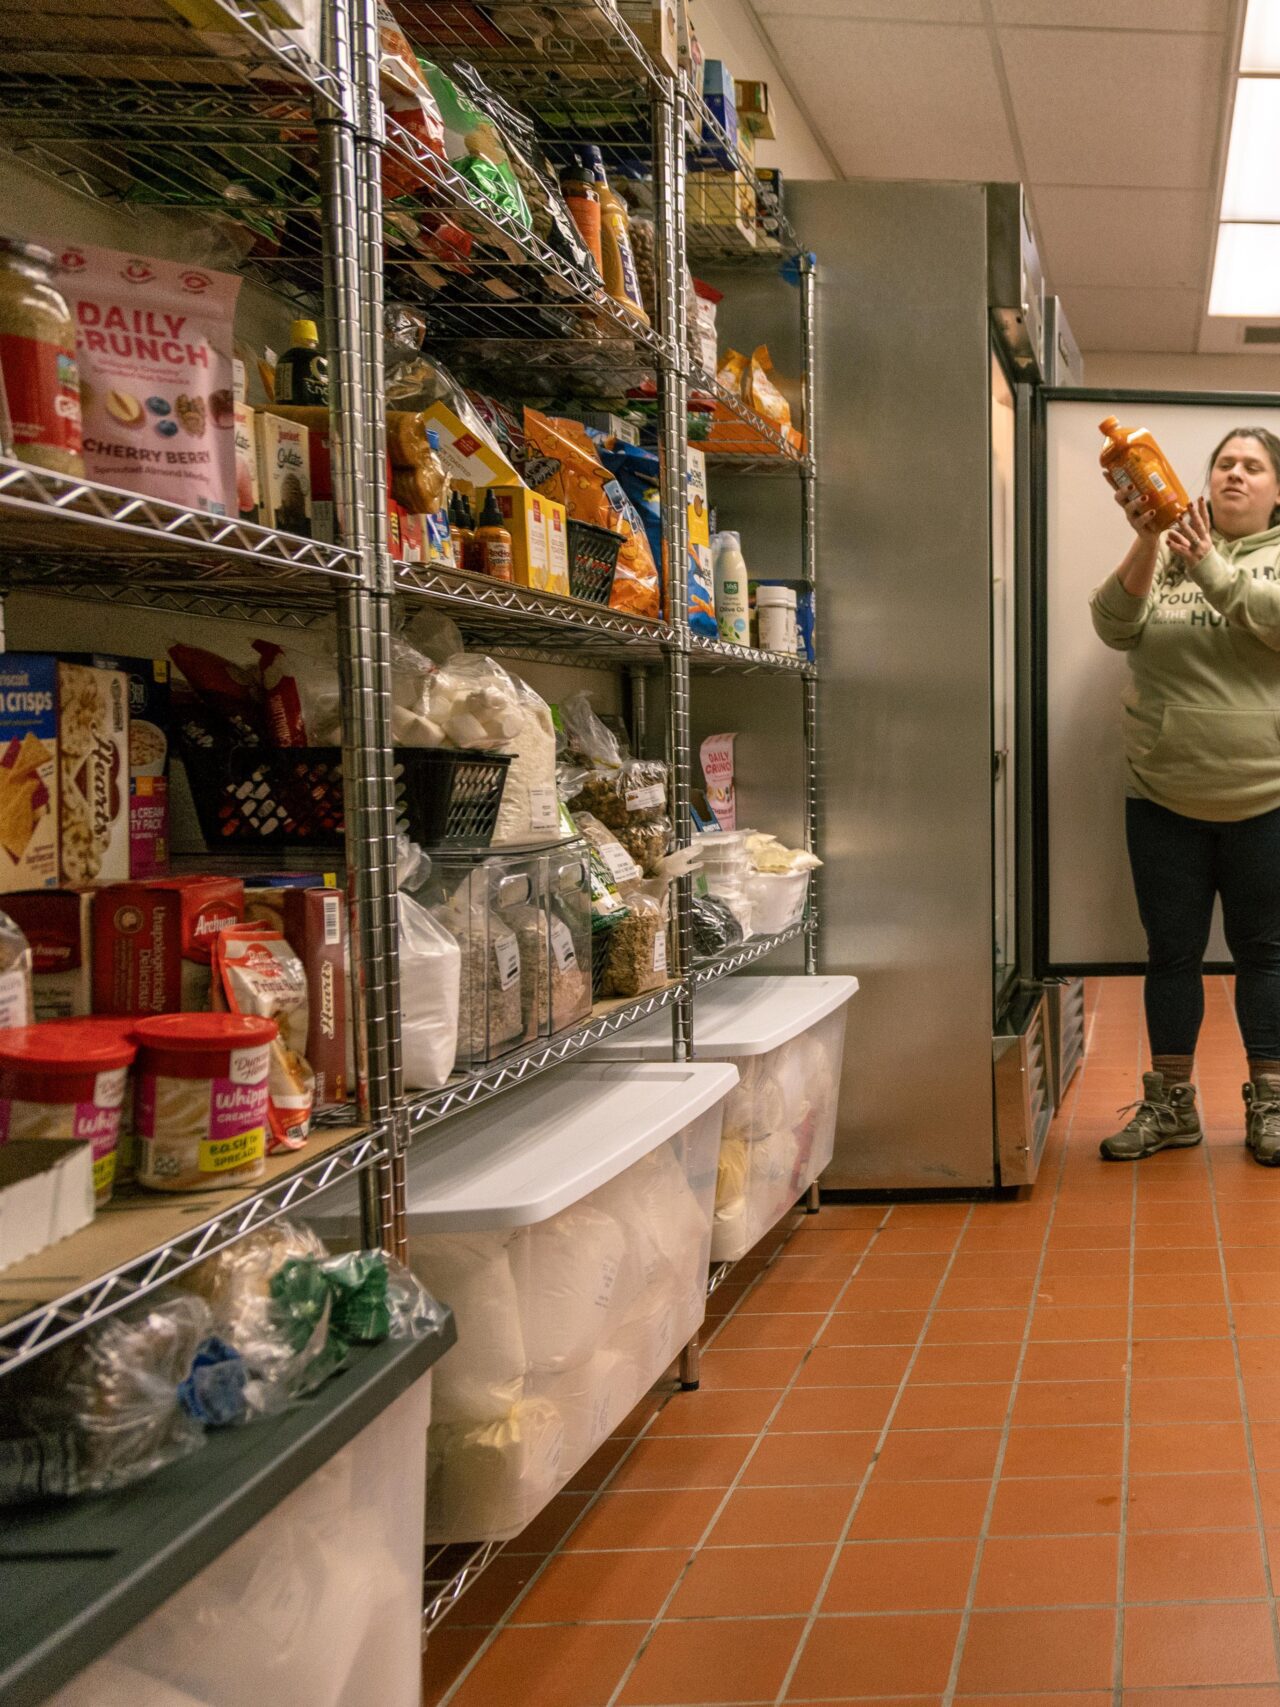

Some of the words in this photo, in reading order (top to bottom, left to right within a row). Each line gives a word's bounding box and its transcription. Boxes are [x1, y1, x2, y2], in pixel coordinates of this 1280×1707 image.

[78, 301, 187, 339] DAILY
[83, 438, 162, 464] CHERRY
[1160, 592, 1206, 605] YOUR
[719, 605, 734, 613] Olive
[736, 605, 745, 613] Oil
[1165, 609, 1187, 619] THE
[1191, 610, 1230, 627] HU
[7, 691, 53, 715] crisps
[708, 751, 729, 764] DAILY
[90, 721, 114, 837] Hearts
[138, 806, 164, 819] CREAM
[143, 818, 162, 830] PACK
[194, 914, 238, 936] Archway
